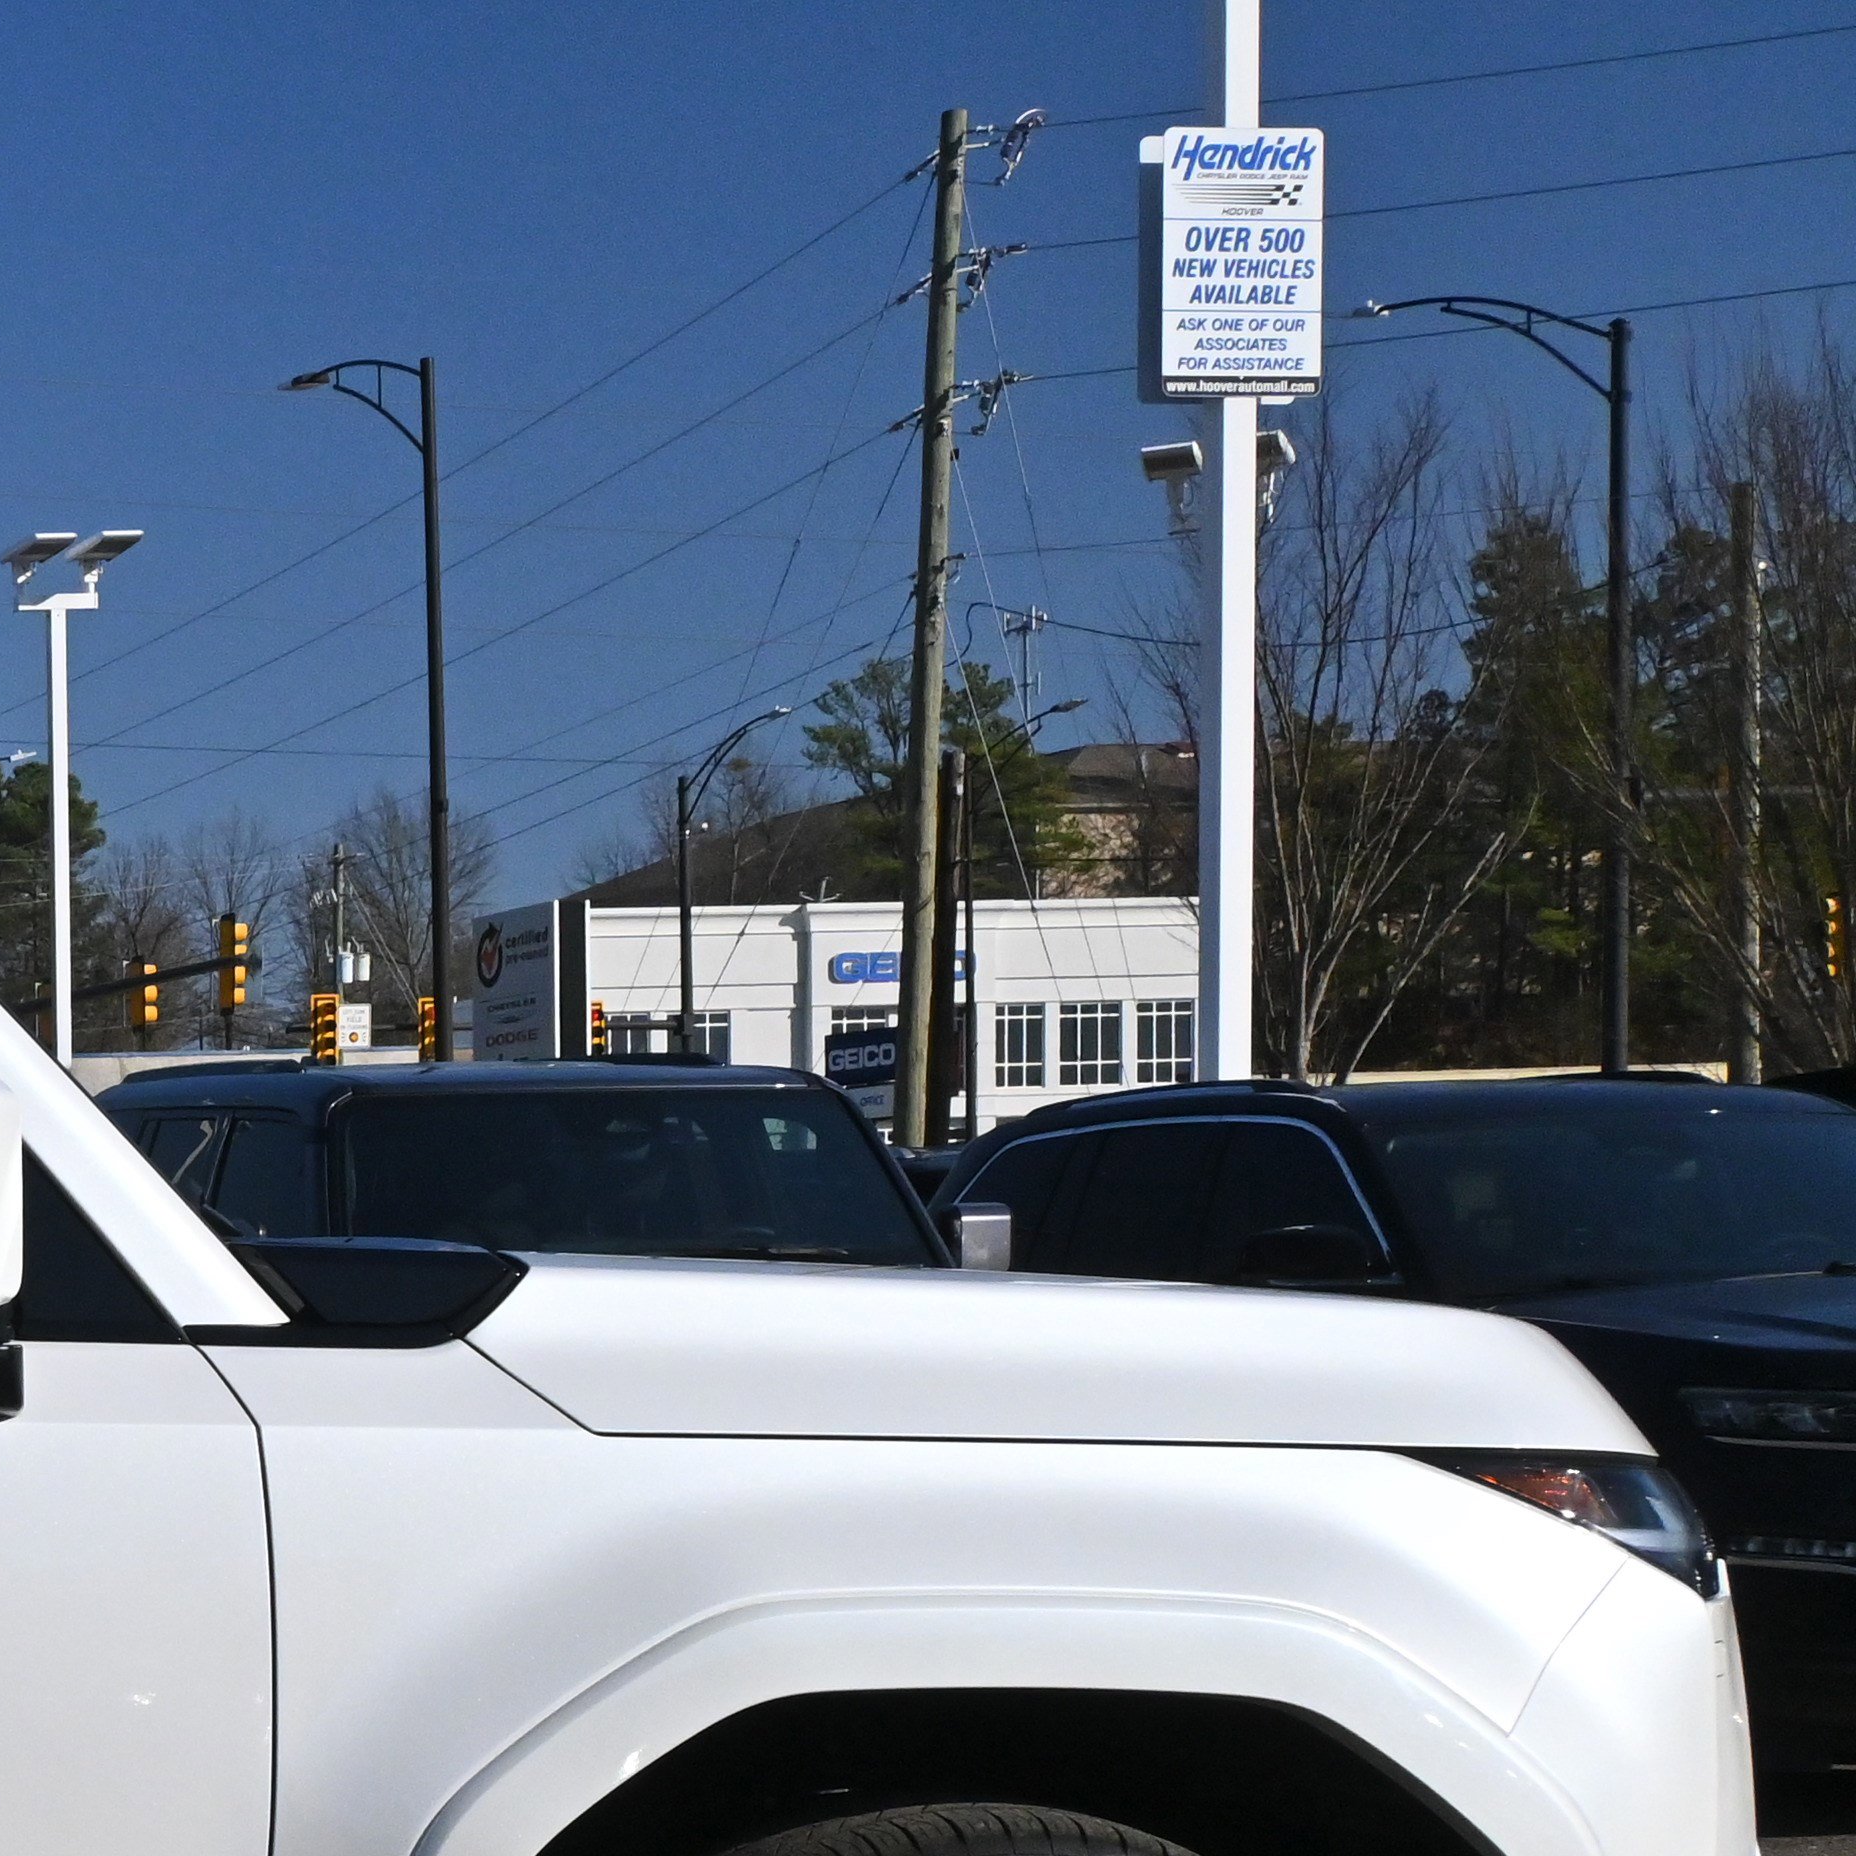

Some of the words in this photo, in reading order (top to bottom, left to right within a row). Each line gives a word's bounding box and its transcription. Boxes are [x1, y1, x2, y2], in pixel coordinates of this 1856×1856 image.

[1171, 135, 1317, 181] Hendrick
[1221, 207, 1264, 216] HOOVER
[1185, 226, 1251, 253] OVER
[1258, 228, 1305, 253] 500
[1172, 258, 1217, 278] NEW
[1223, 259, 1316, 279] VEHICLES
[1189, 285, 1297, 304] AVAILABLE
[1176, 318, 1206, 331] ASK
[1212, 318, 1244, 331] ONE
[1248, 319, 1269, 331] OF
[1273, 319, 1305, 331] OUR
[1194, 338, 1287, 351] ASSOCIATES
[1177, 357, 1207, 370] FOR
[1212, 357, 1304, 370] ASSISTANCE
[1166, 380, 1315, 393] www.hooverautomall.com
[828, 1042, 895, 1072] GEICO
